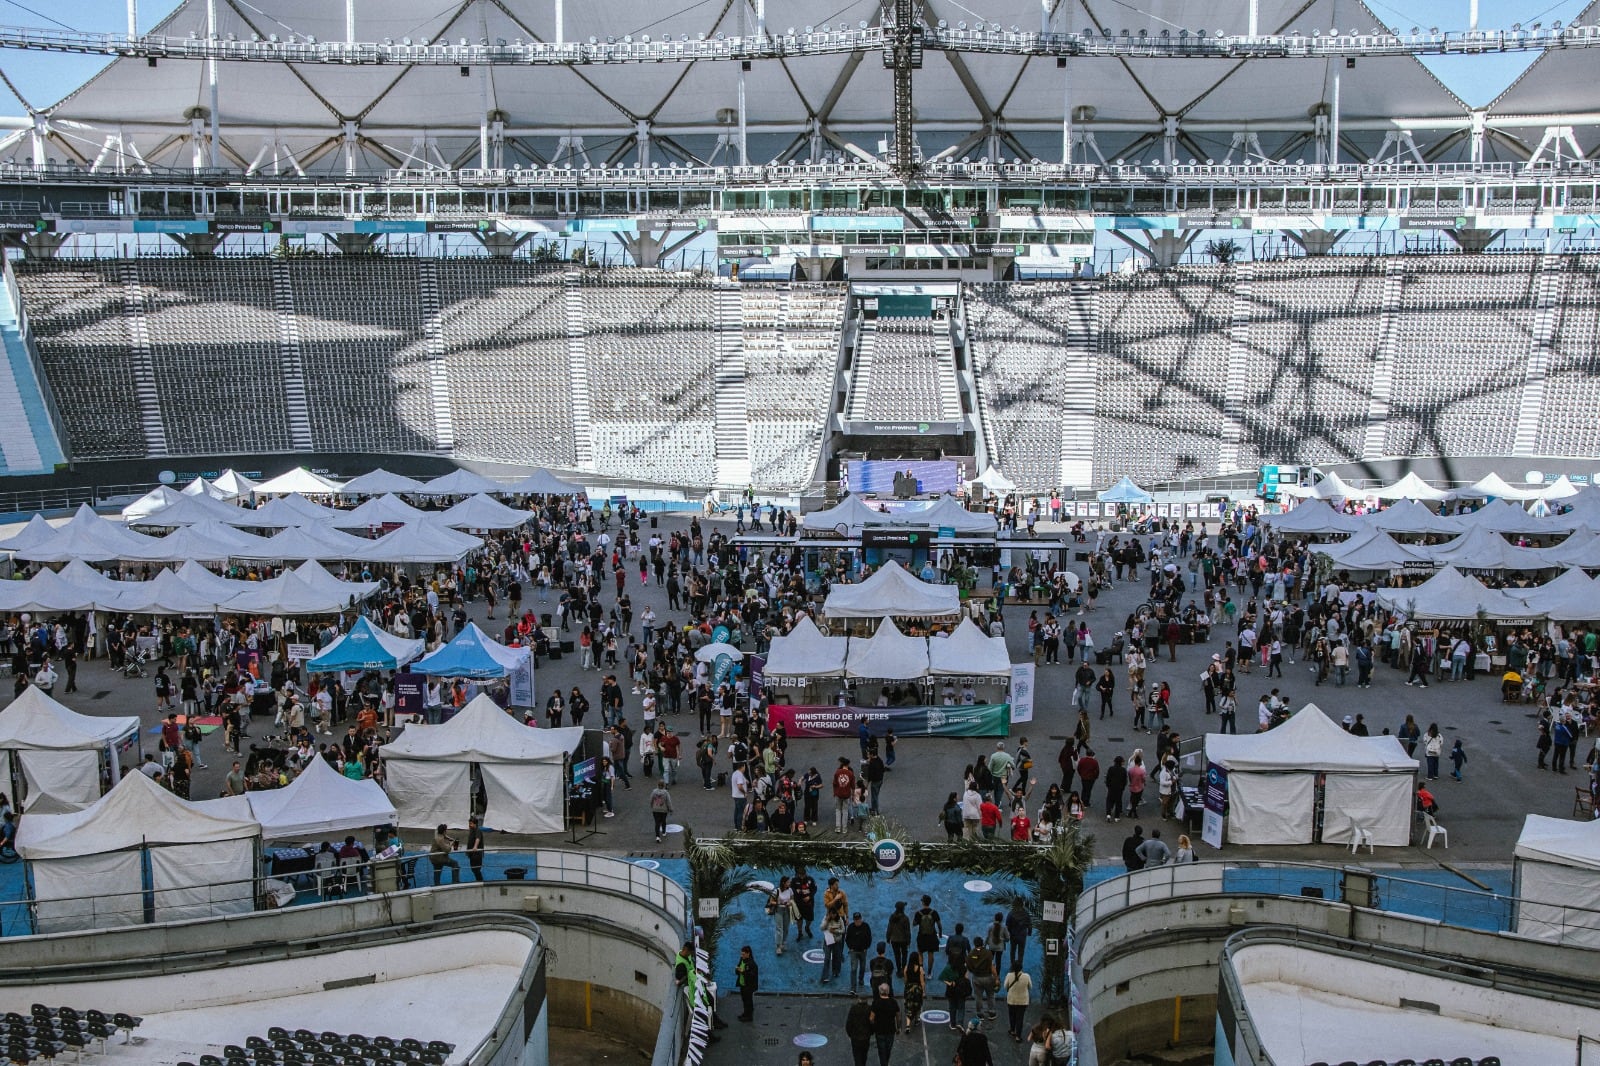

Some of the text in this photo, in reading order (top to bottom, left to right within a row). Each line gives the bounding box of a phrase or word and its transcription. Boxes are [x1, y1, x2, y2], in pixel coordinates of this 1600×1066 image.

[364, 661, 384, 669] MDA
[715, 658, 732, 680] ARBA
[795, 713, 840, 721] MINISTERIO
[842, 713, 853, 721] DE
[795, 721, 850, 729] Y DIVERSIDAD
